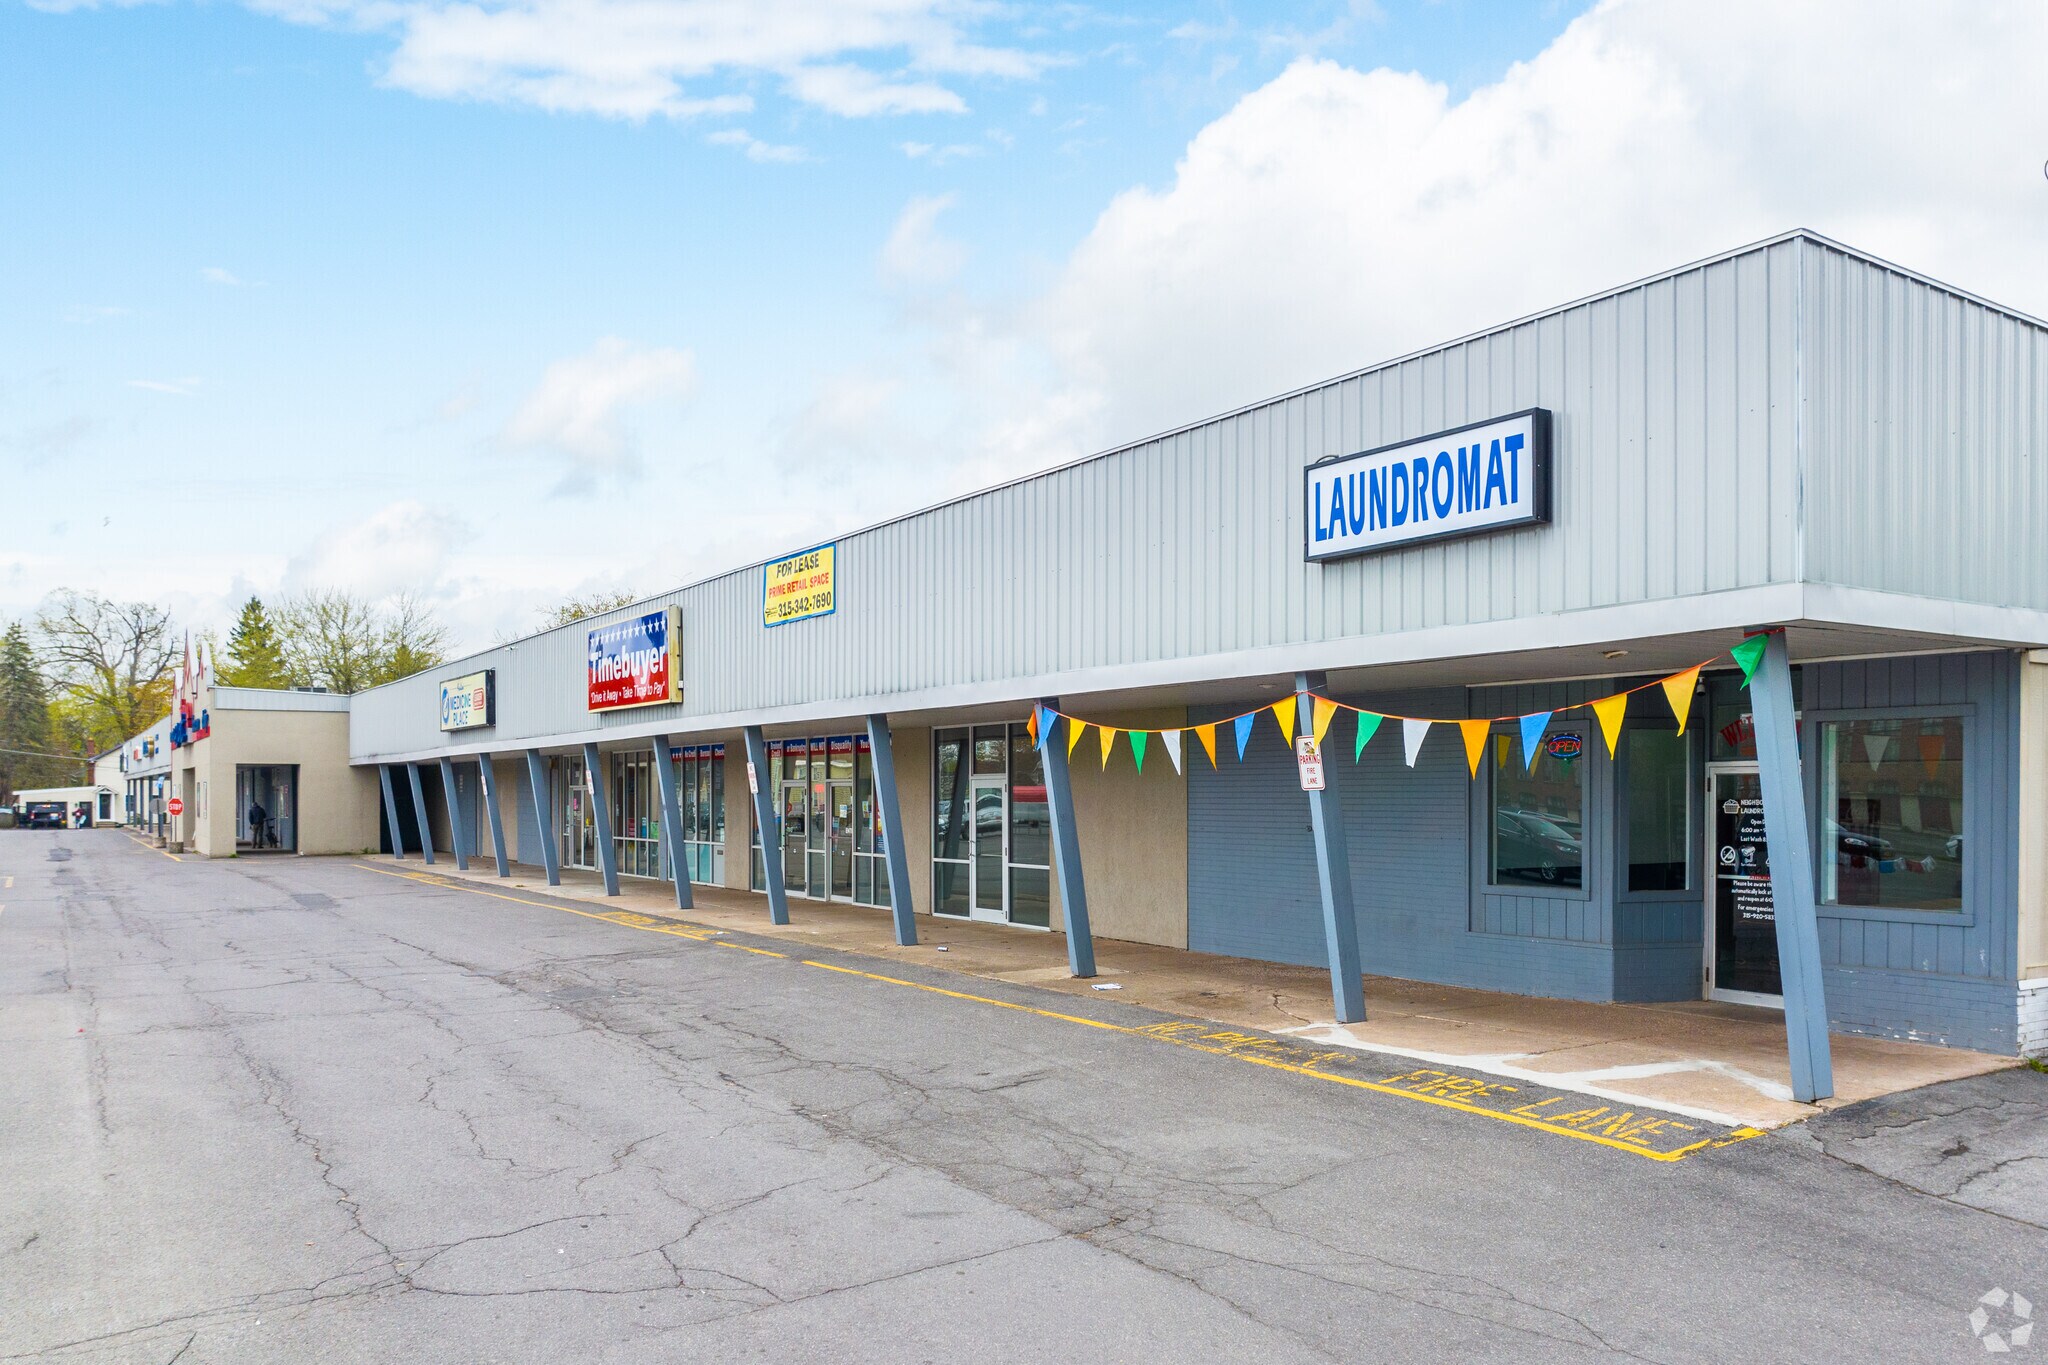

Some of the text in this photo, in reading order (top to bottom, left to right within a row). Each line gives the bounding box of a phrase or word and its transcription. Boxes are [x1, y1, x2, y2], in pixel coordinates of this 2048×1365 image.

[1315, 433, 1524, 542] LAUNDROMAT
[777, 553, 819, 578] FOR LEASE
[769, 572, 829, 599] PRIME RETAIL SPACE
[778, 591, 831, 617] 315-342-7690
[590, 645, 665, 685] Timebuyer
[450, 693, 471, 710] MEDICINE
[607, 690, 618, 703] Away
[622, 686, 633, 699] Take
[634, 684, 647, 697] Time
[647, 684, 653, 696] to
[453, 711, 468, 726] PLACE
[831, 740, 851, 751] Disqualify
[1548, 741, 1581, 753] OPEN
[1300, 754, 1320, 764] PARKING
[1379, 1070, 1518, 1103] FIRE
[1510, 1097, 1694, 1145] LANE
